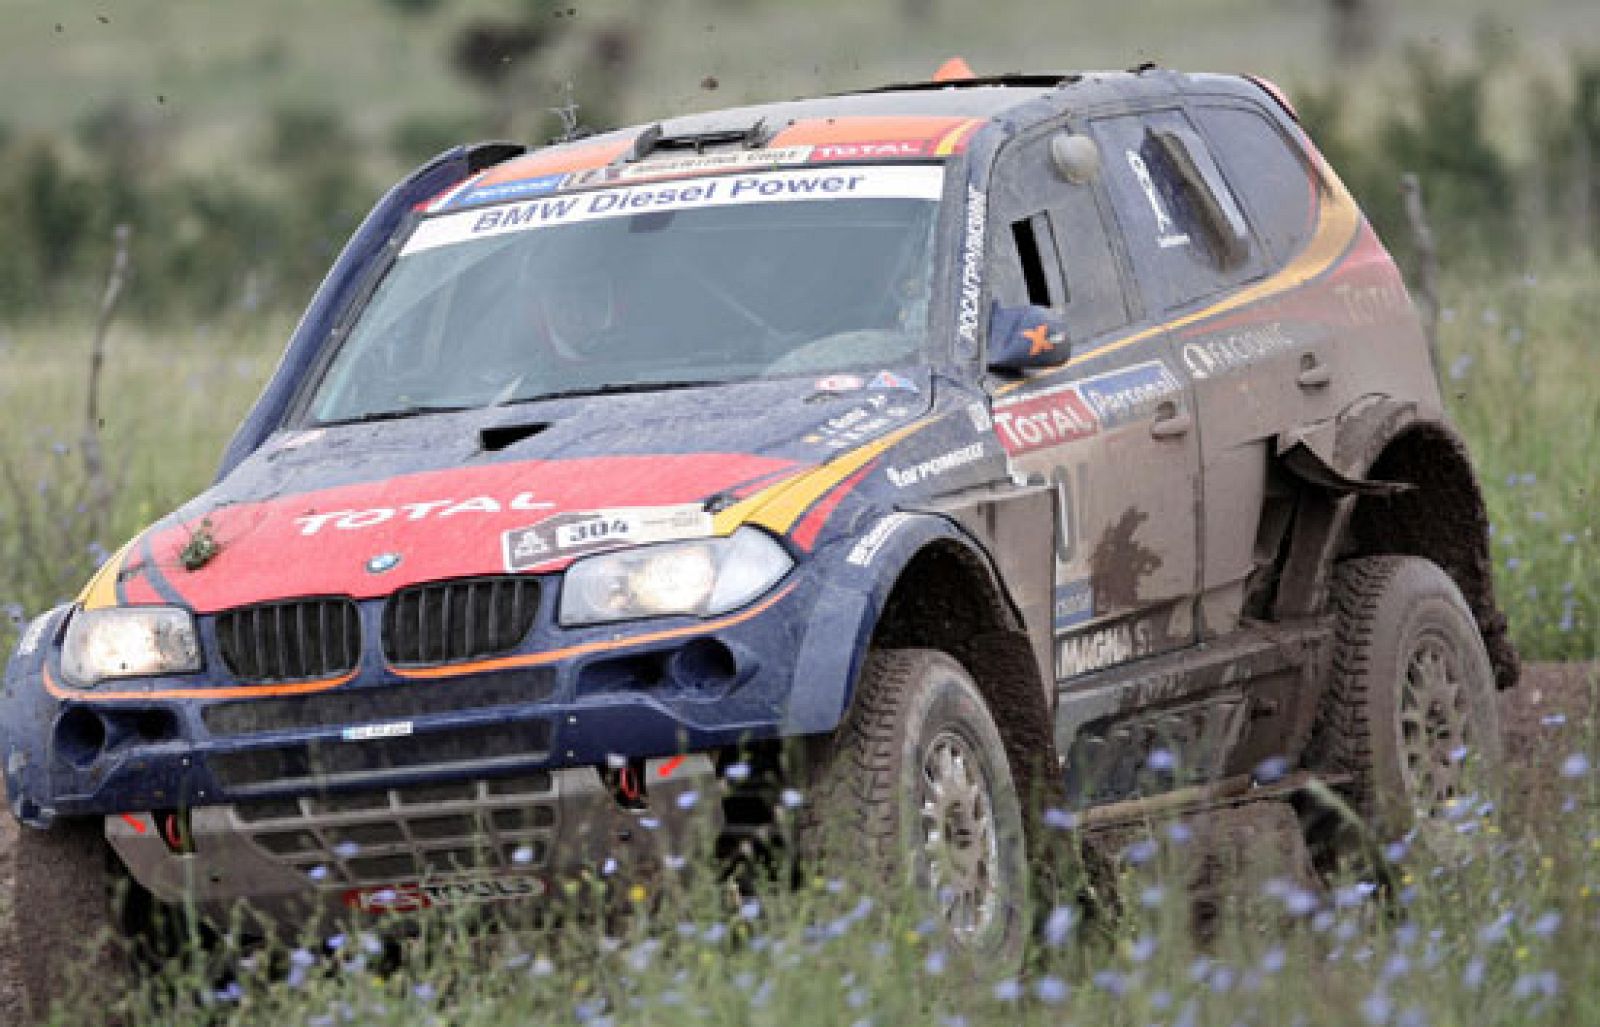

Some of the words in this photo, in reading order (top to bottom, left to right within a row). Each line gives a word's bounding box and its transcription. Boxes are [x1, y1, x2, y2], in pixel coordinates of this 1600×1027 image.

[821, 143, 921, 156] TOTAL
[474, 198, 579, 233] BMW
[588, 181, 716, 212] Diesel
[730, 173, 866, 199] Power
[993, 404, 1093, 449] TOTAL
[293, 491, 557, 536] TOTAL
[569, 518, 630, 542] 304
